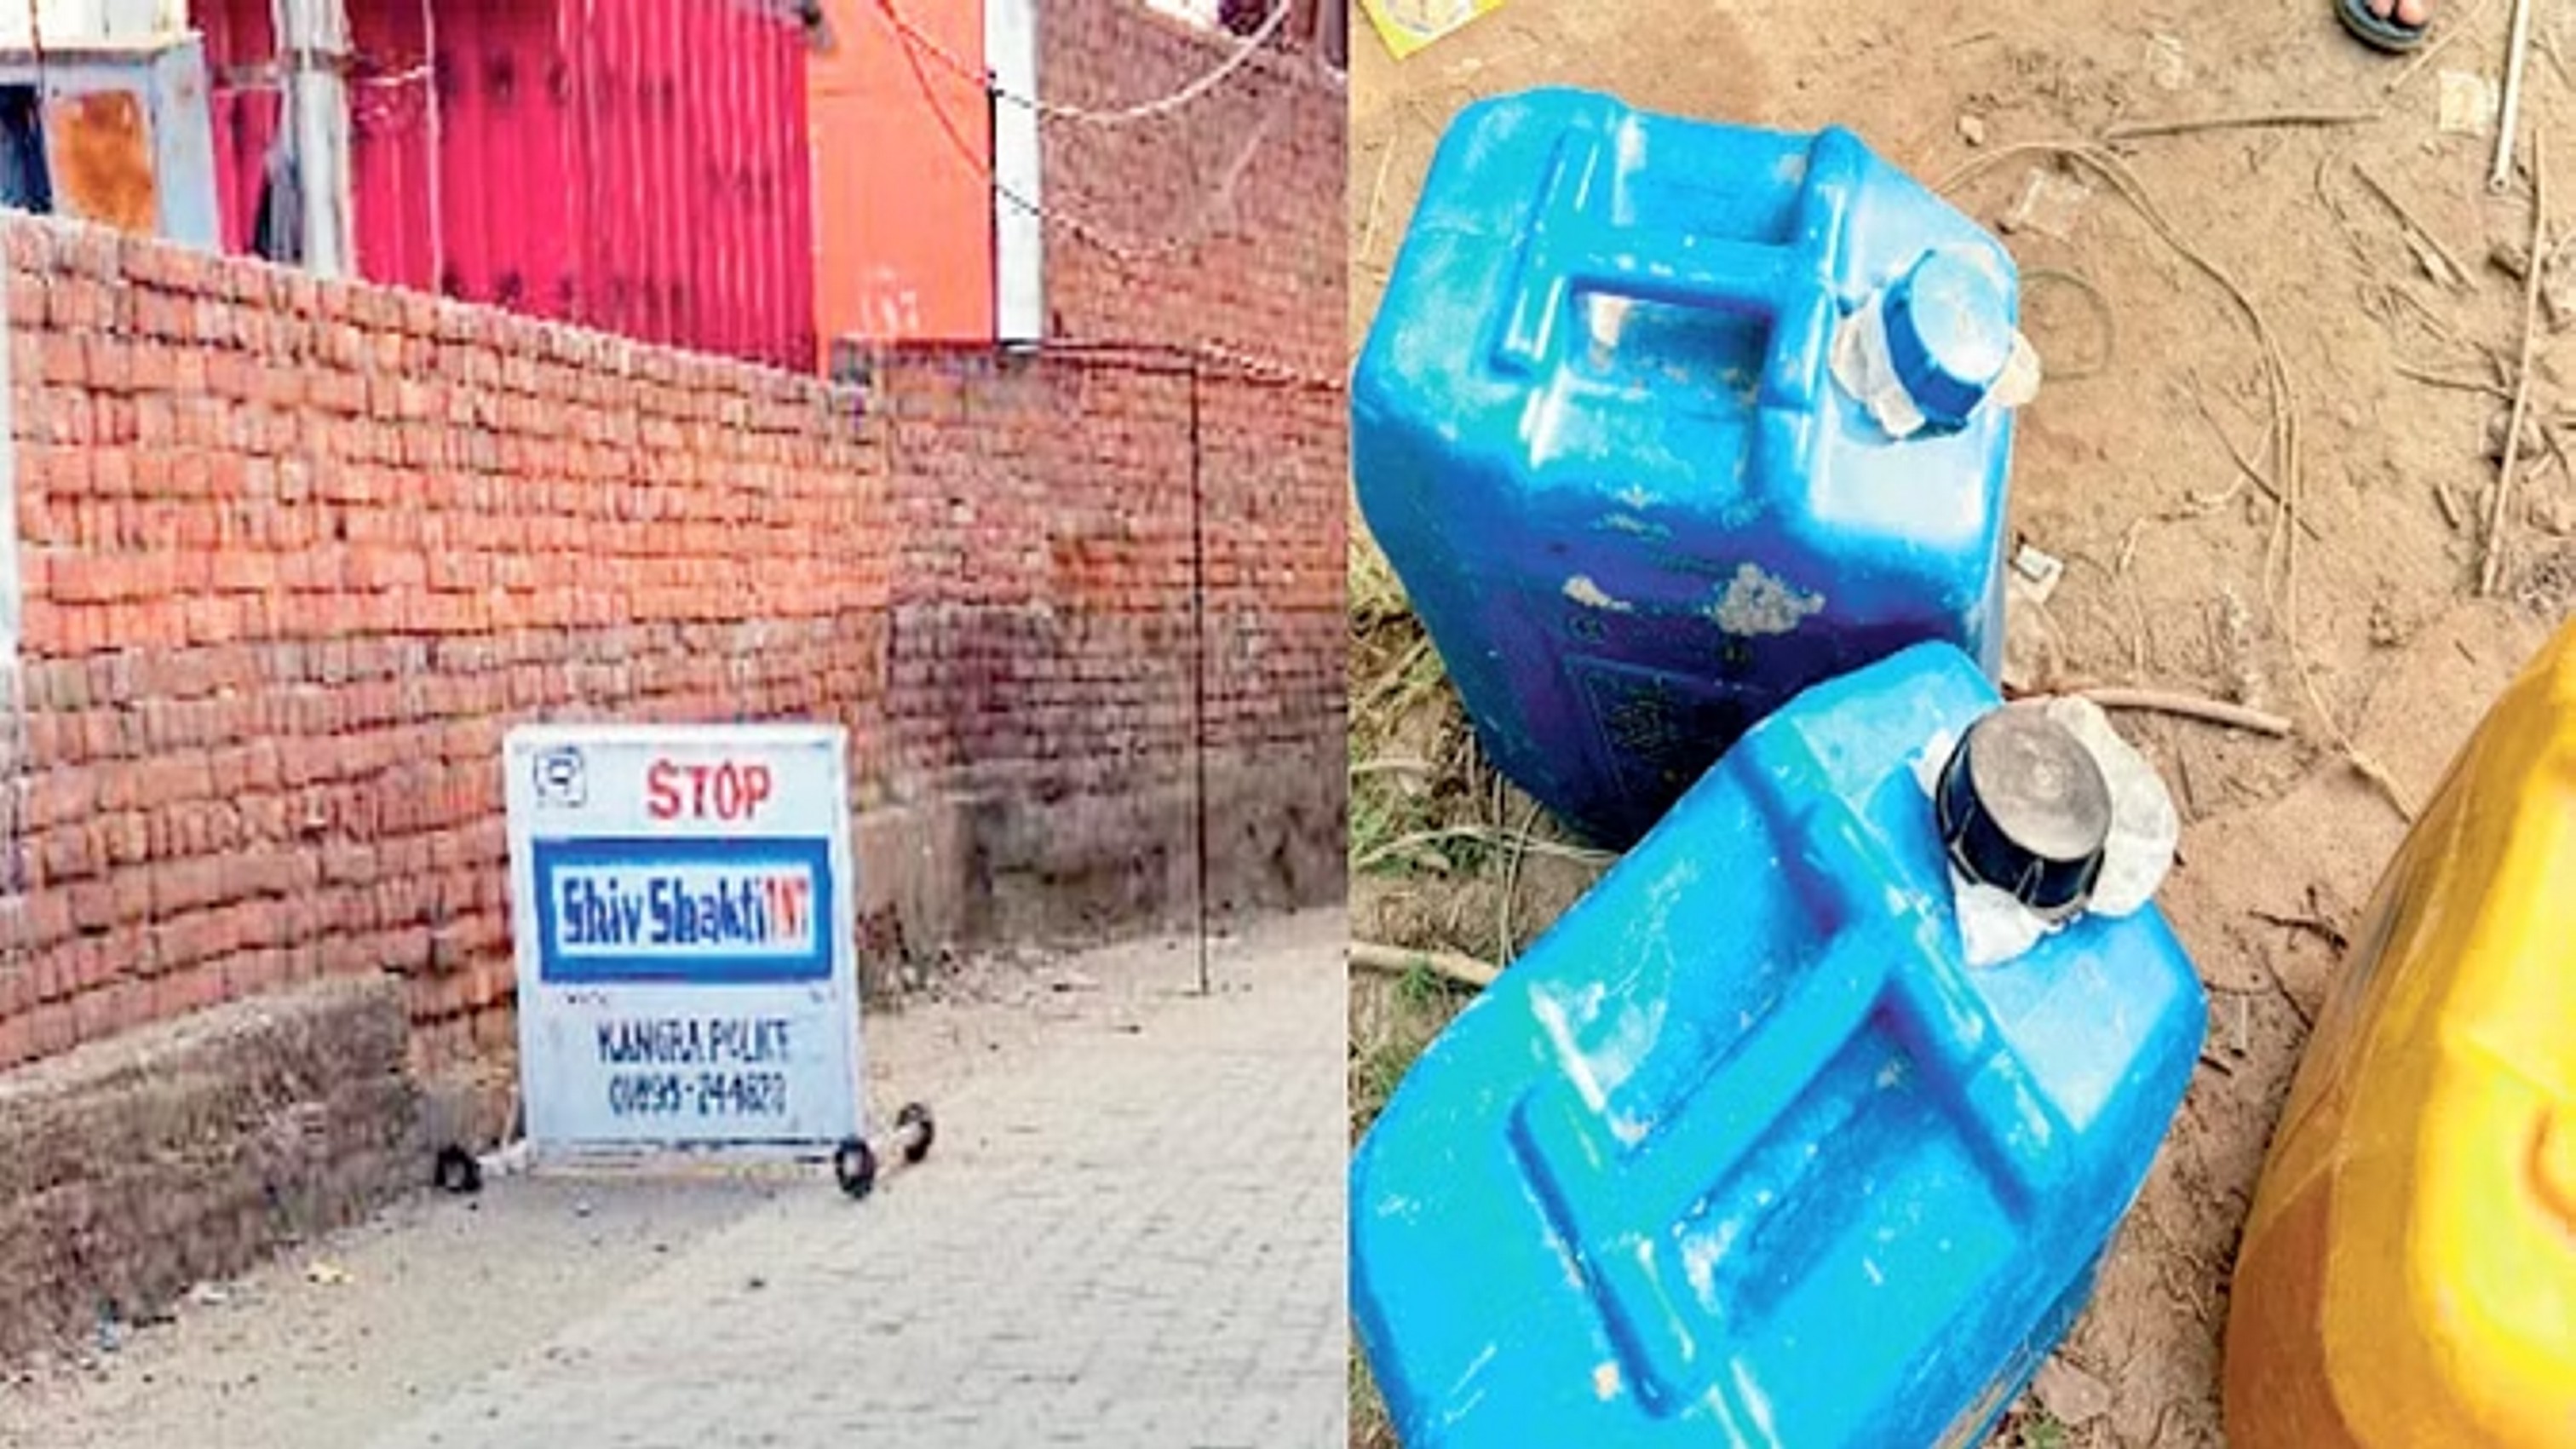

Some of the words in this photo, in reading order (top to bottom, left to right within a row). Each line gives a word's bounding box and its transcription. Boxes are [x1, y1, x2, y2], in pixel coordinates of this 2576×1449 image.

[647, 758, 772, 820] STOP
[563, 877, 642, 944] Shiv
[649, 877, 765, 944] Shakti
